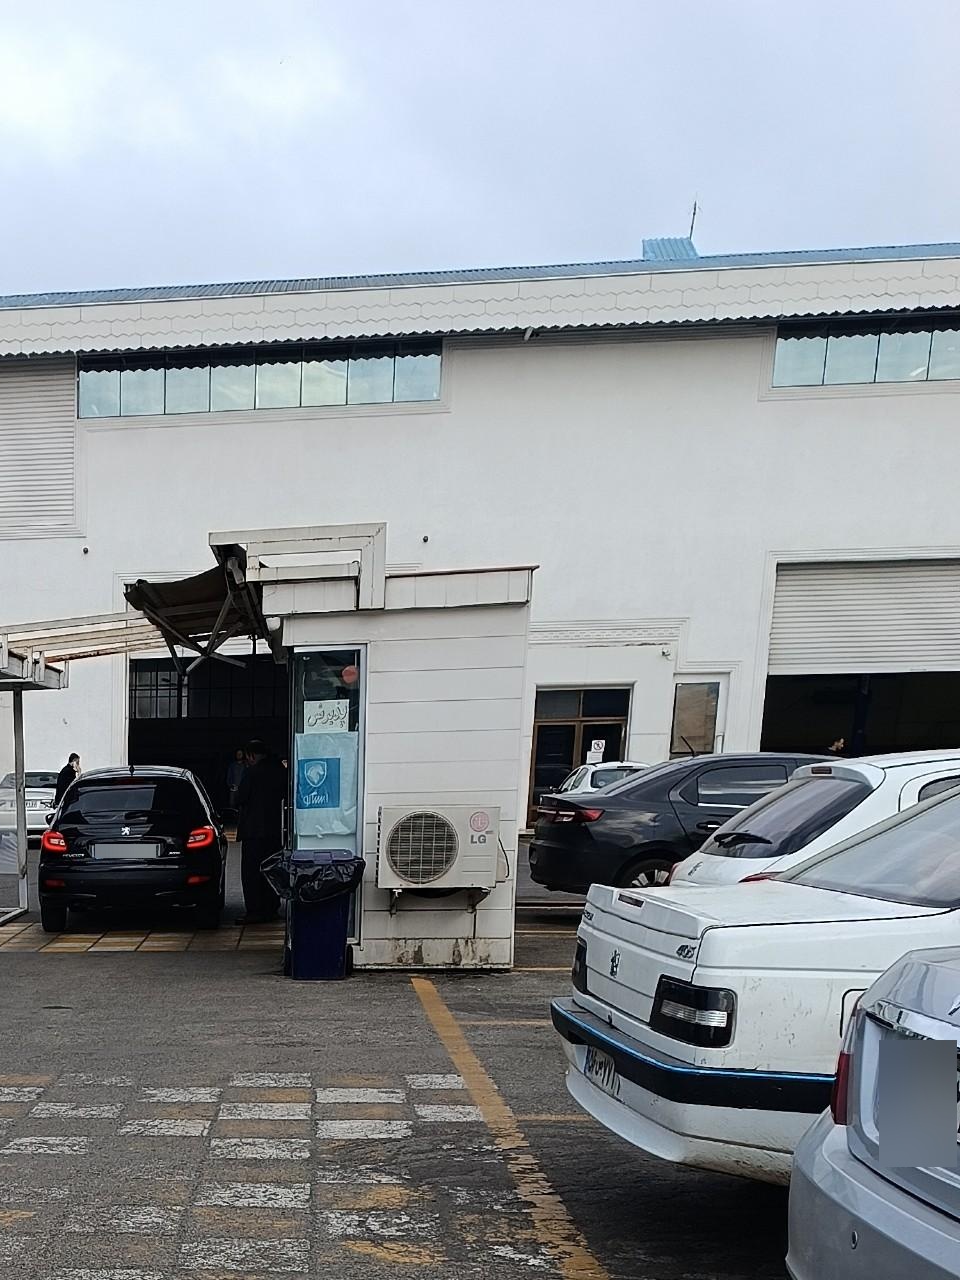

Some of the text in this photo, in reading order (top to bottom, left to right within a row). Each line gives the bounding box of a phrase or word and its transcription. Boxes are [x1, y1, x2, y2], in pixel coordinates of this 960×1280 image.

[307, 701, 348, 729] پذیرش
[470, 834, 487, 845] LG
[676, 944, 697, 959] 405
